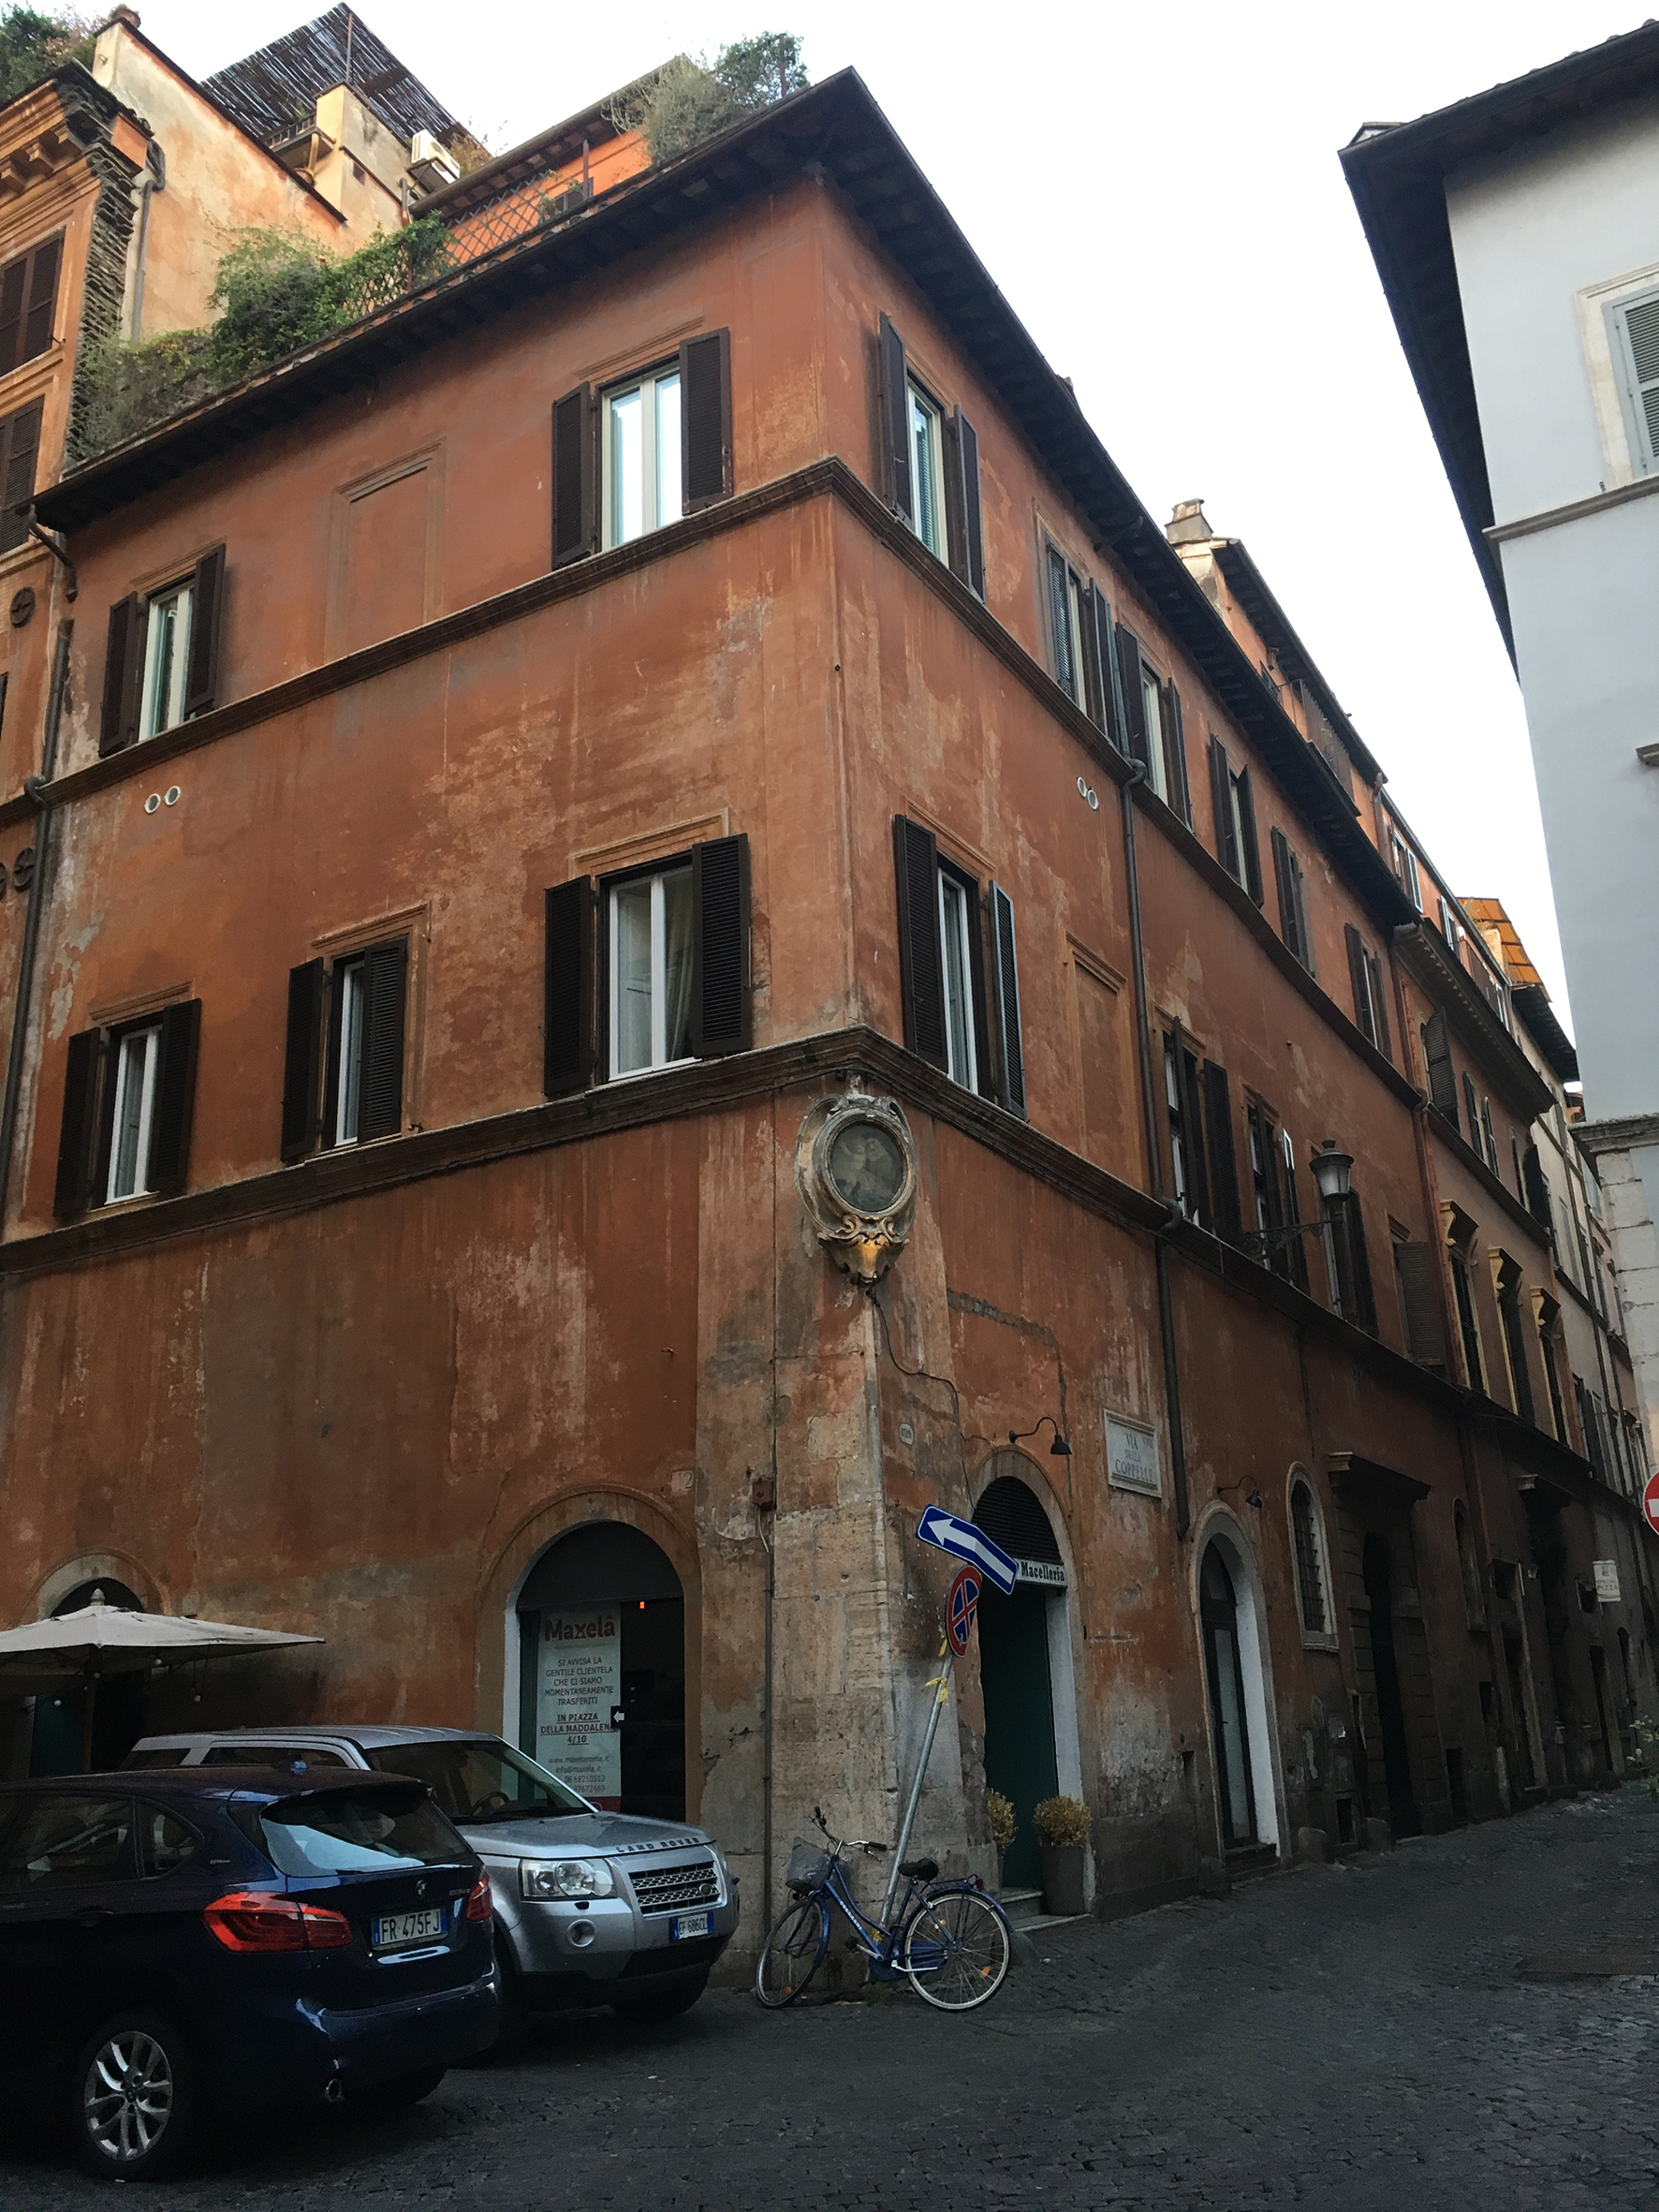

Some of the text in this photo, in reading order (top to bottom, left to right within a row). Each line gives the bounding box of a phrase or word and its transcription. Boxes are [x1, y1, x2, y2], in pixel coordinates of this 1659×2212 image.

[1125, 1433, 1138, 1450] VIA
[1124, 1448, 1141, 1463] DELLE
[1115, 1458, 1153, 1482] COPPELLE
[1020, 1561, 1065, 1581] Macelleria
[557, 1659, 565, 1667] SI
[566, 1658, 592, 1666] AVVISA
[545, 1666, 613, 1677] GENTILE CLIENTELA
[553, 1678, 568, 1687] CHE
[580, 1676, 602, 1685] SIAMO
[545, 1686, 614, 1696] MOMENTANEAMENTE
[557, 1696, 598, 1705] TRASFERITI
[557, 1713, 598, 1722] IN PIAZZA
[540, 1725, 565, 1733] DELLA
[567, 1735, 587, 1744] 4/10
[616, 1837, 699, 1852] LAND ROVER
[380, 1911, 441, 1942] FR 475FJ
